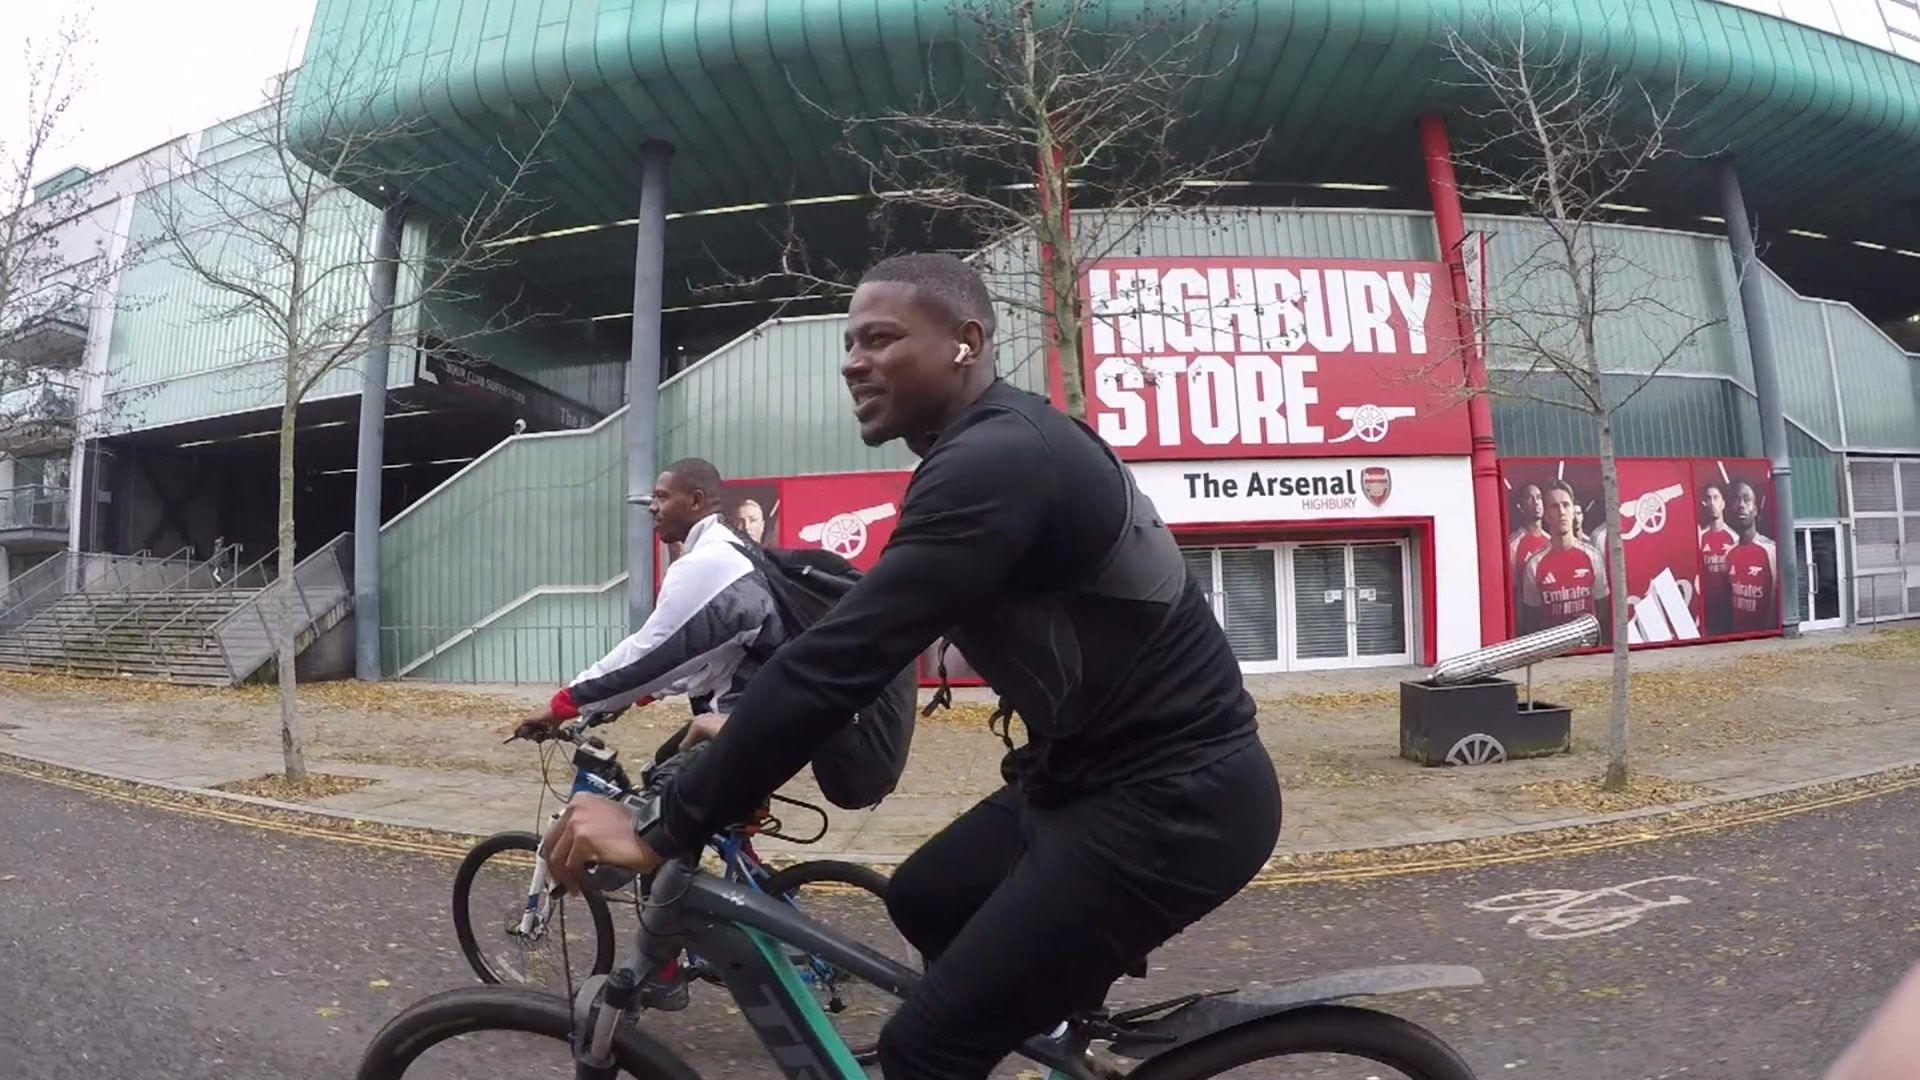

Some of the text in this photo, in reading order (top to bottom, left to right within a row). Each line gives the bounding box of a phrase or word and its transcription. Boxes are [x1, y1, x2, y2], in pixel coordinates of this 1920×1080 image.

[1089, 268, 1432, 354] HIGHBURY
[1094, 354, 1325, 447] STORE
[1184, 469, 1357, 499] The Arsenal
[1302, 498, 1357, 511] HIGHBURY
[1543, 586, 1591, 605] Emirates
